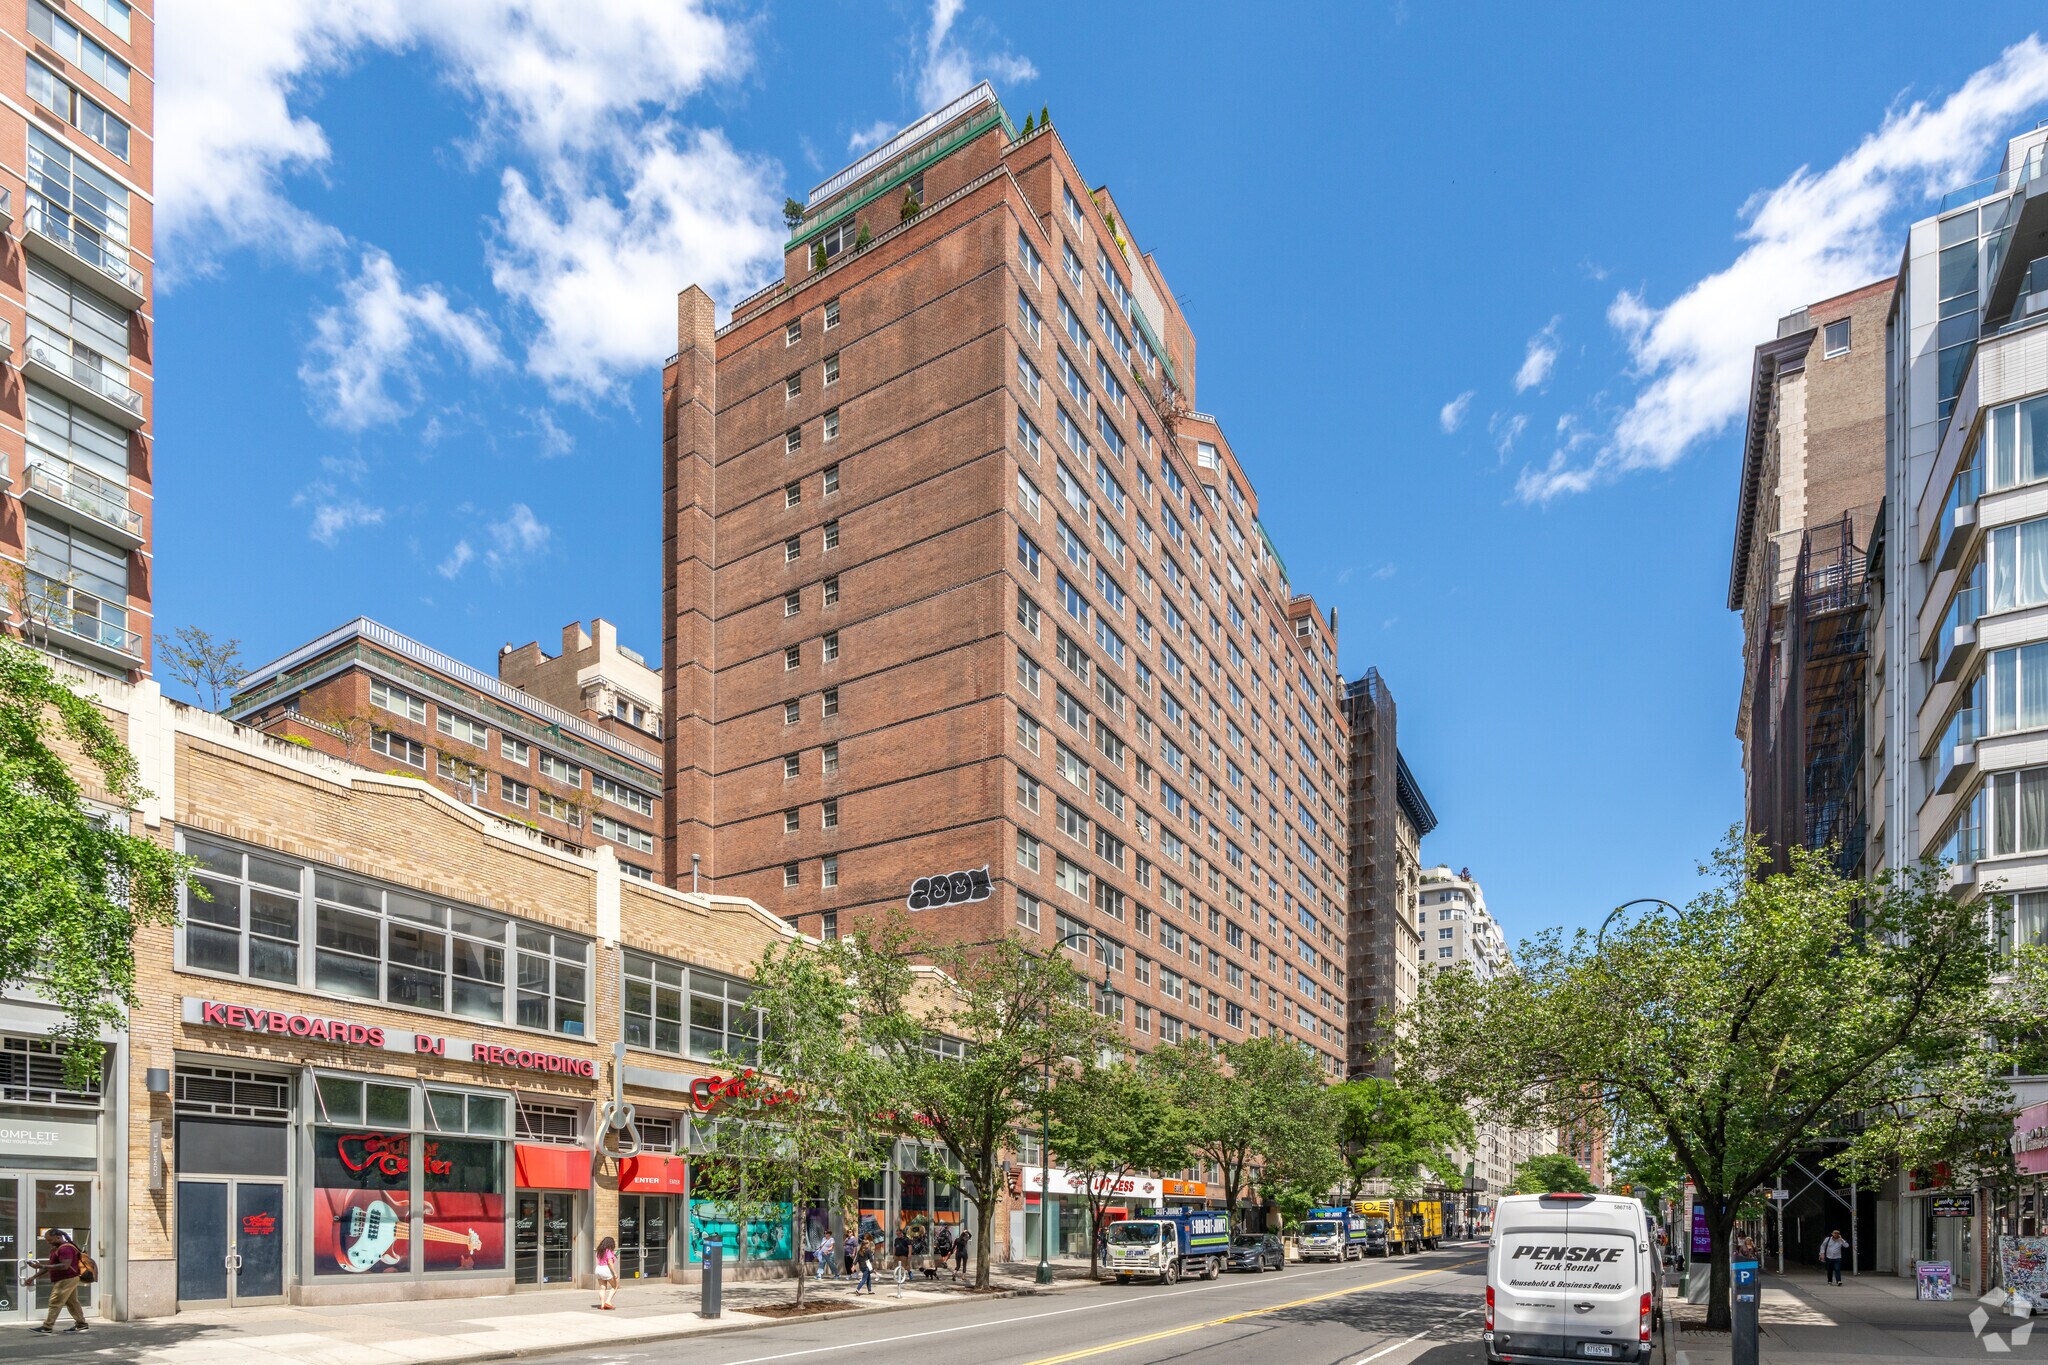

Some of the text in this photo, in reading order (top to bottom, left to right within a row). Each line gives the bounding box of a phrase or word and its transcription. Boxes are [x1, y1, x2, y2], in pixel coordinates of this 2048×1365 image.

[202, 1002, 594, 1077] KEYBOARDS DJ RECORDING
[379, 1154, 452, 1175] Ceter
[54, 1183, 75, 1196] 25
[1093, 1177, 1135, 1193] LOT-LESS
[1933, 1197, 1971, 1207] Smoke Shop
[1511, 1245, 1625, 1263] PENSKE
[1534, 1262, 1600, 1273] Truck Rental
[1740, 1271, 1750, 1283] P
[1509, 1279, 1548, 1288] Household
[1556, 1281, 1592, 1289] Business
[1592, 1282, 1622, 1290] Rentals
